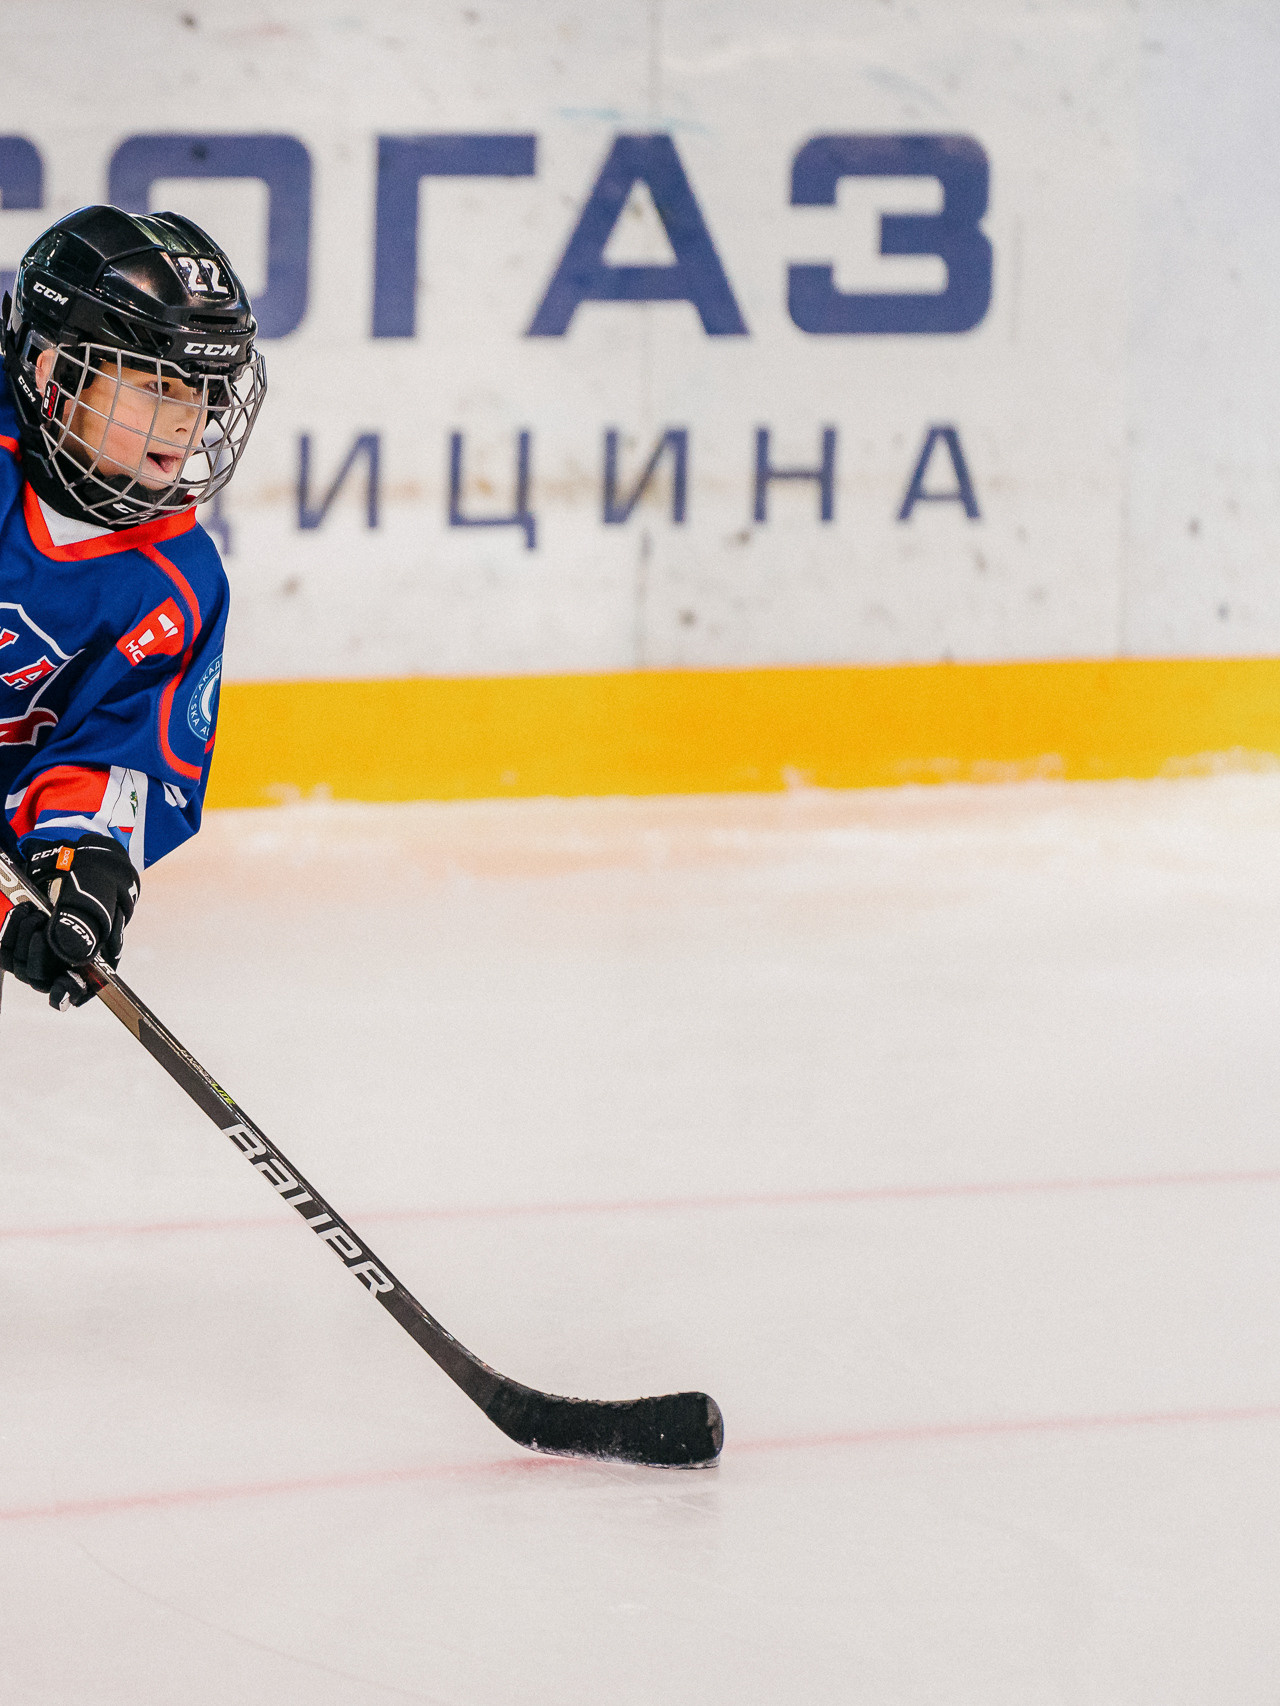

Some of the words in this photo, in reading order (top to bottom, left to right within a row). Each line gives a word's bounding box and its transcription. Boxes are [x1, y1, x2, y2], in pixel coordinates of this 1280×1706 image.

[177, 256, 228, 294] 22
[33, 281, 70, 306] CCM
[183, 341, 241, 357] CCM
[18, 375, 37, 402] CCM
[59, 917, 94, 946] CCM
